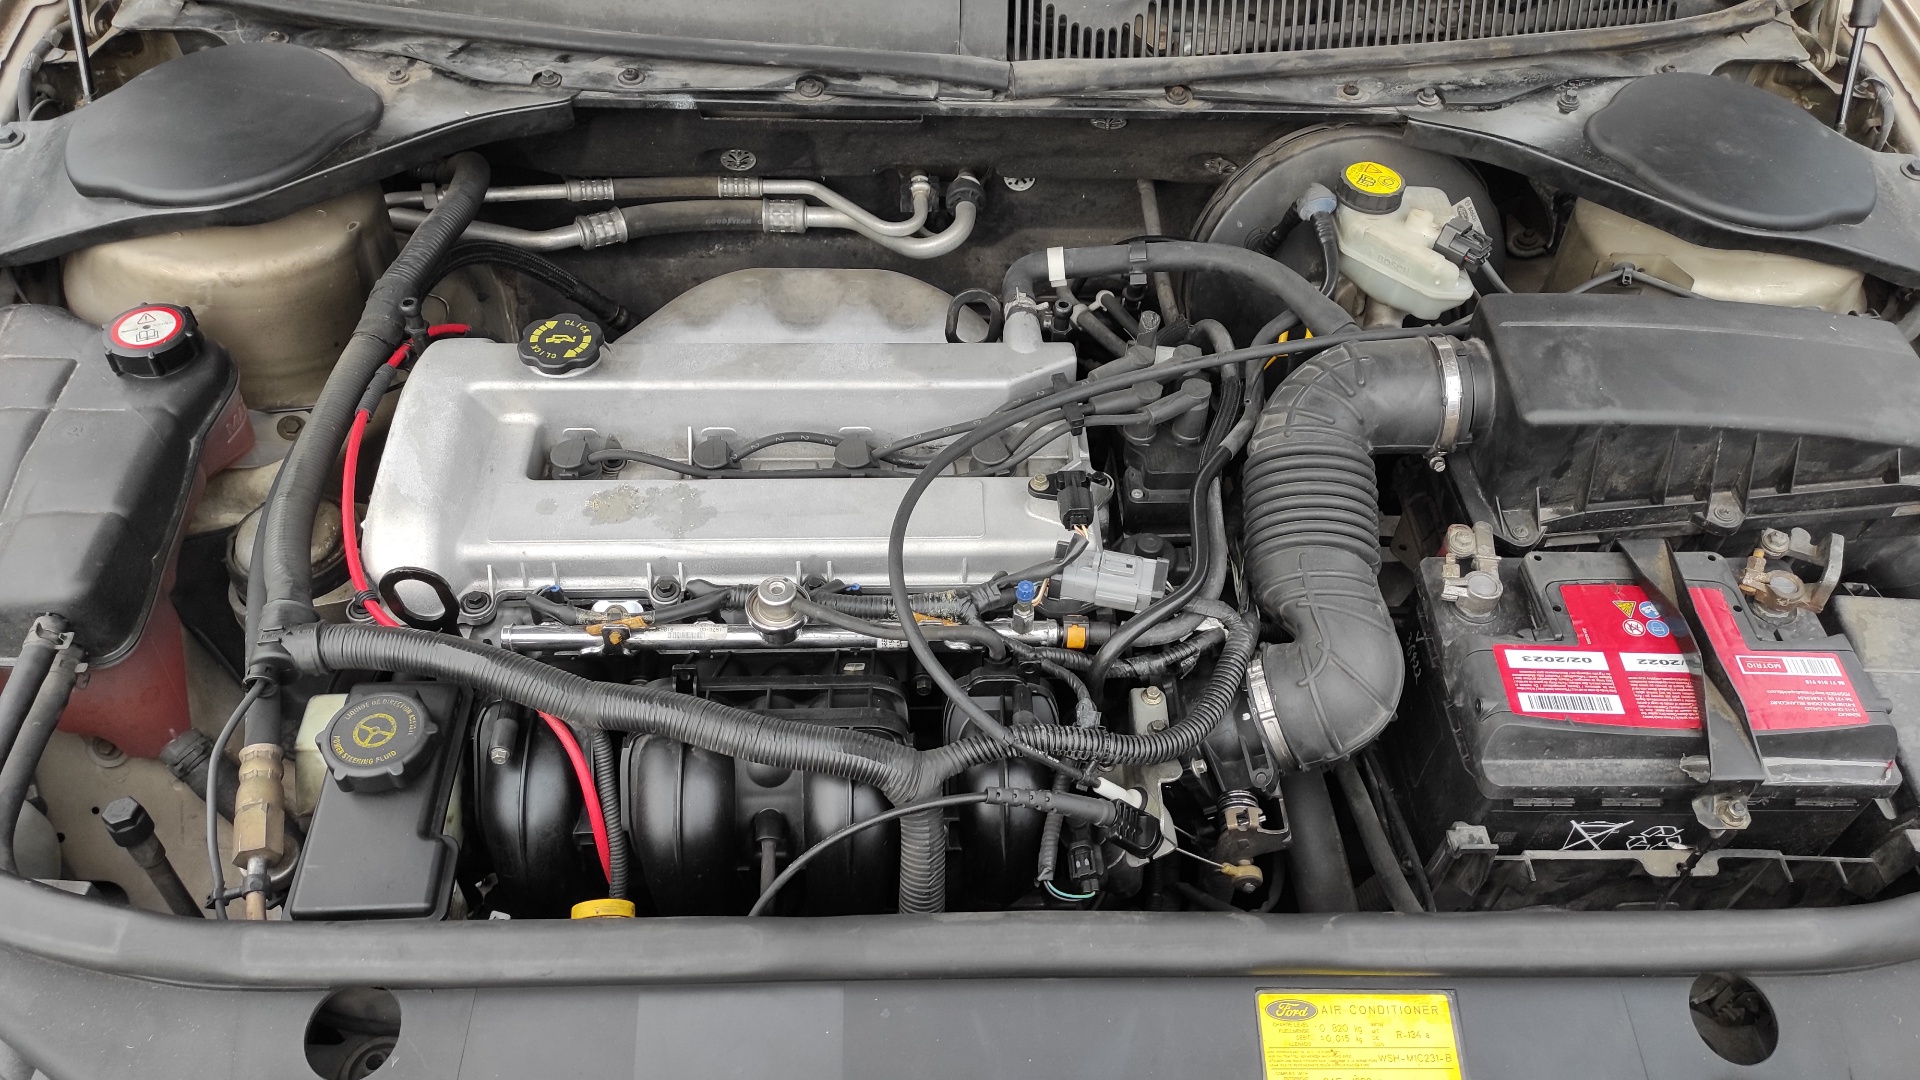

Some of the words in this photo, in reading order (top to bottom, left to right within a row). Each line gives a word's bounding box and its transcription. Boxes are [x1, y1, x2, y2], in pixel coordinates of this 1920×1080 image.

[1377, 253, 1410, 275] BOSCH
[564, 319, 591, 334] CLICK
[530, 344, 557, 359] CLICK
[1522, 655, 1592, 664] 02/2023
[1746, 662, 1782, 670] MOTRIO
[344, 702, 370, 720] LIQUIDE
[382, 698, 413, 715] DIRECTION
[333, 735, 345, 756] POWER
[342, 752, 374, 765] STEERING
[375, 750, 397, 763] FLUID
[1275, 1002, 1309, 1018] Ford
[1321, 1005, 1342, 1015] AIR
[1349, 1004, 1439, 1015] CONDITIONER
